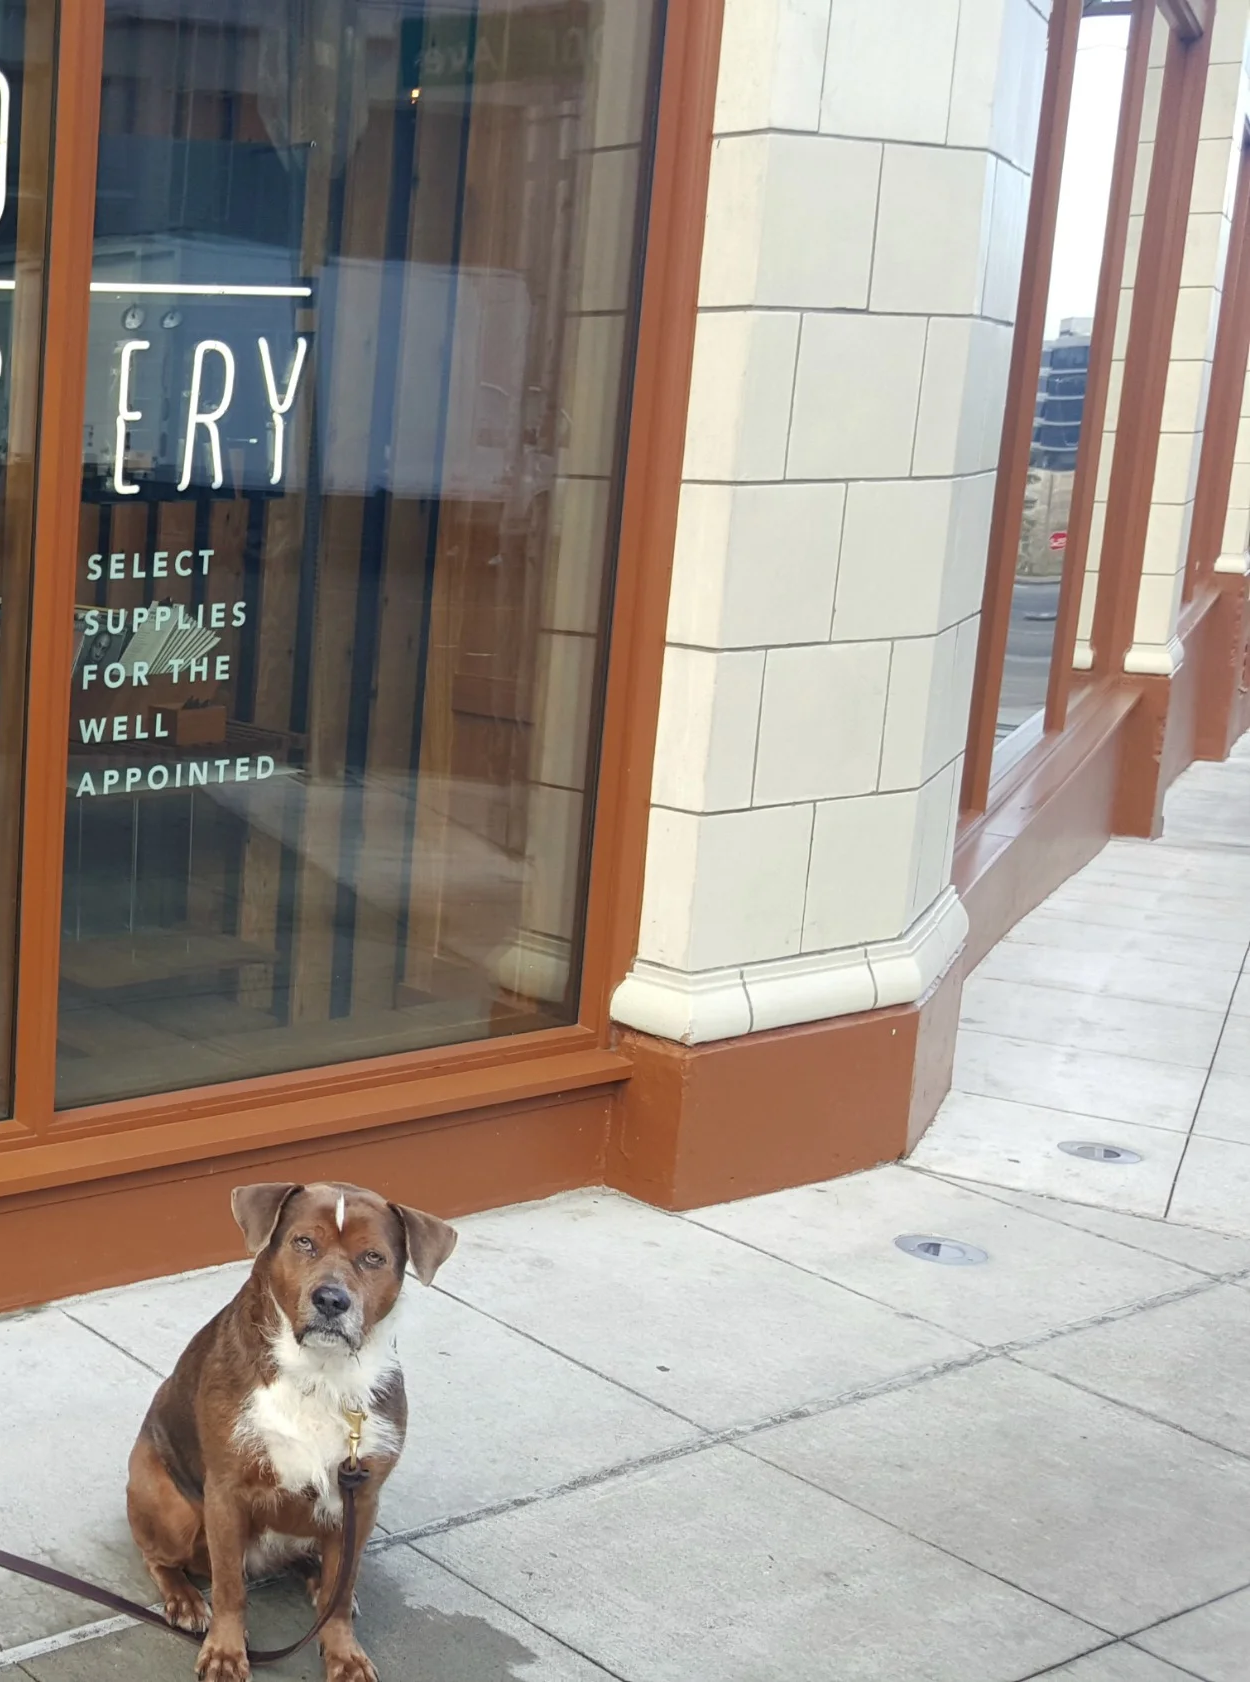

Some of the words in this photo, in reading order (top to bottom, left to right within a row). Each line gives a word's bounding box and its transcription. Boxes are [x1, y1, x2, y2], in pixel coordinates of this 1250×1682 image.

[86, 549, 215, 581] SELECT
[84, 601, 248, 636] SUPPLIES
[82, 661, 150, 690] FOR
[168, 655, 231, 684] THE
[79, 713, 169, 744] WELL
[75, 755, 275, 798] APPOINTED
